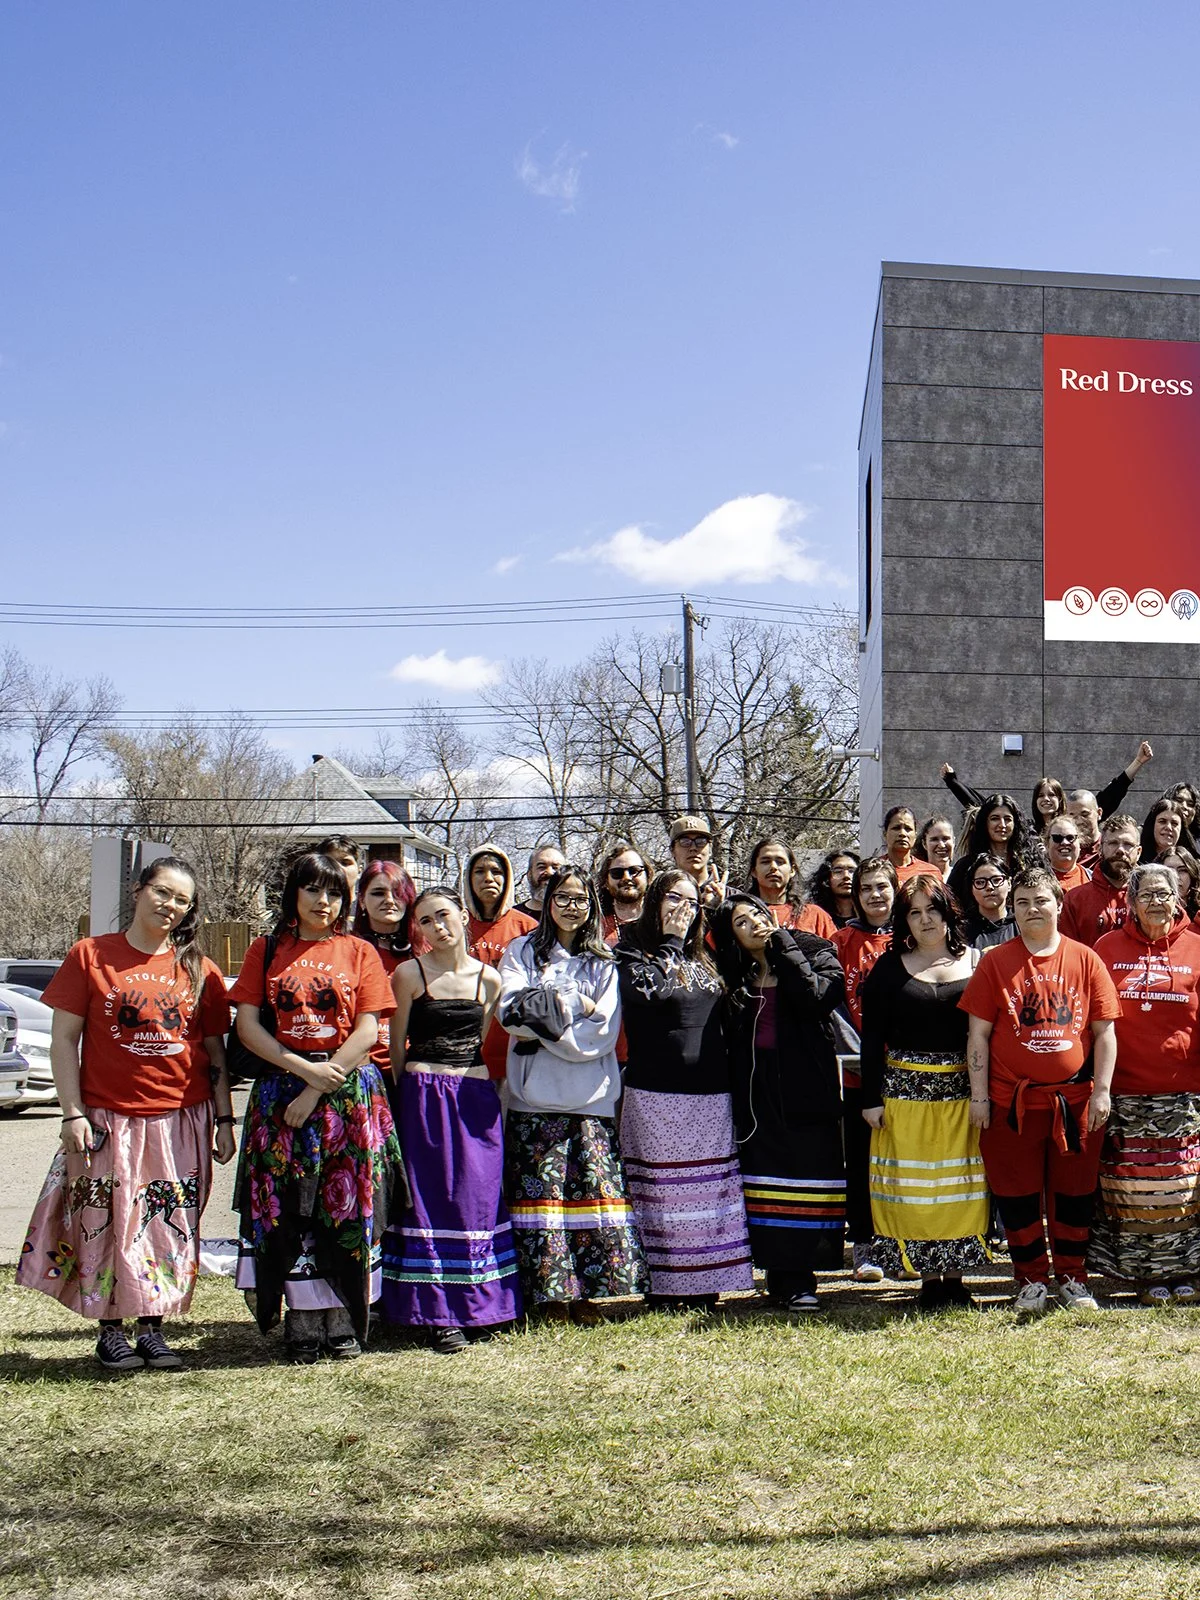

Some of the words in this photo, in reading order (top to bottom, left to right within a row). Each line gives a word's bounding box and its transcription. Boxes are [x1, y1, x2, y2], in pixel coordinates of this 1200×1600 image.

[1060, 368, 1109, 392] Red
[1117, 371, 1193, 396] Dress
[469, 942, 506, 954] STOLEN
[1112, 962, 1148, 970] NATIONAL
[125, 972, 176, 986] STOLEN
[846, 966, 859, 991] MORE
[1024, 974, 1064, 987] STOLEN
[104, 986, 120, 1016] MORE
[1120, 990, 1139, 999] PITCH
[1008, 988, 1022, 1015] MORE
[1068, 986, 1083, 1036] SISTERS
[110, 1024, 122, 1040] NO
[134, 1032, 172, 1041] #MMIW
[1012, 1024, 1020, 1037] NO
[1030, 1029, 1064, 1038] #MMIW
